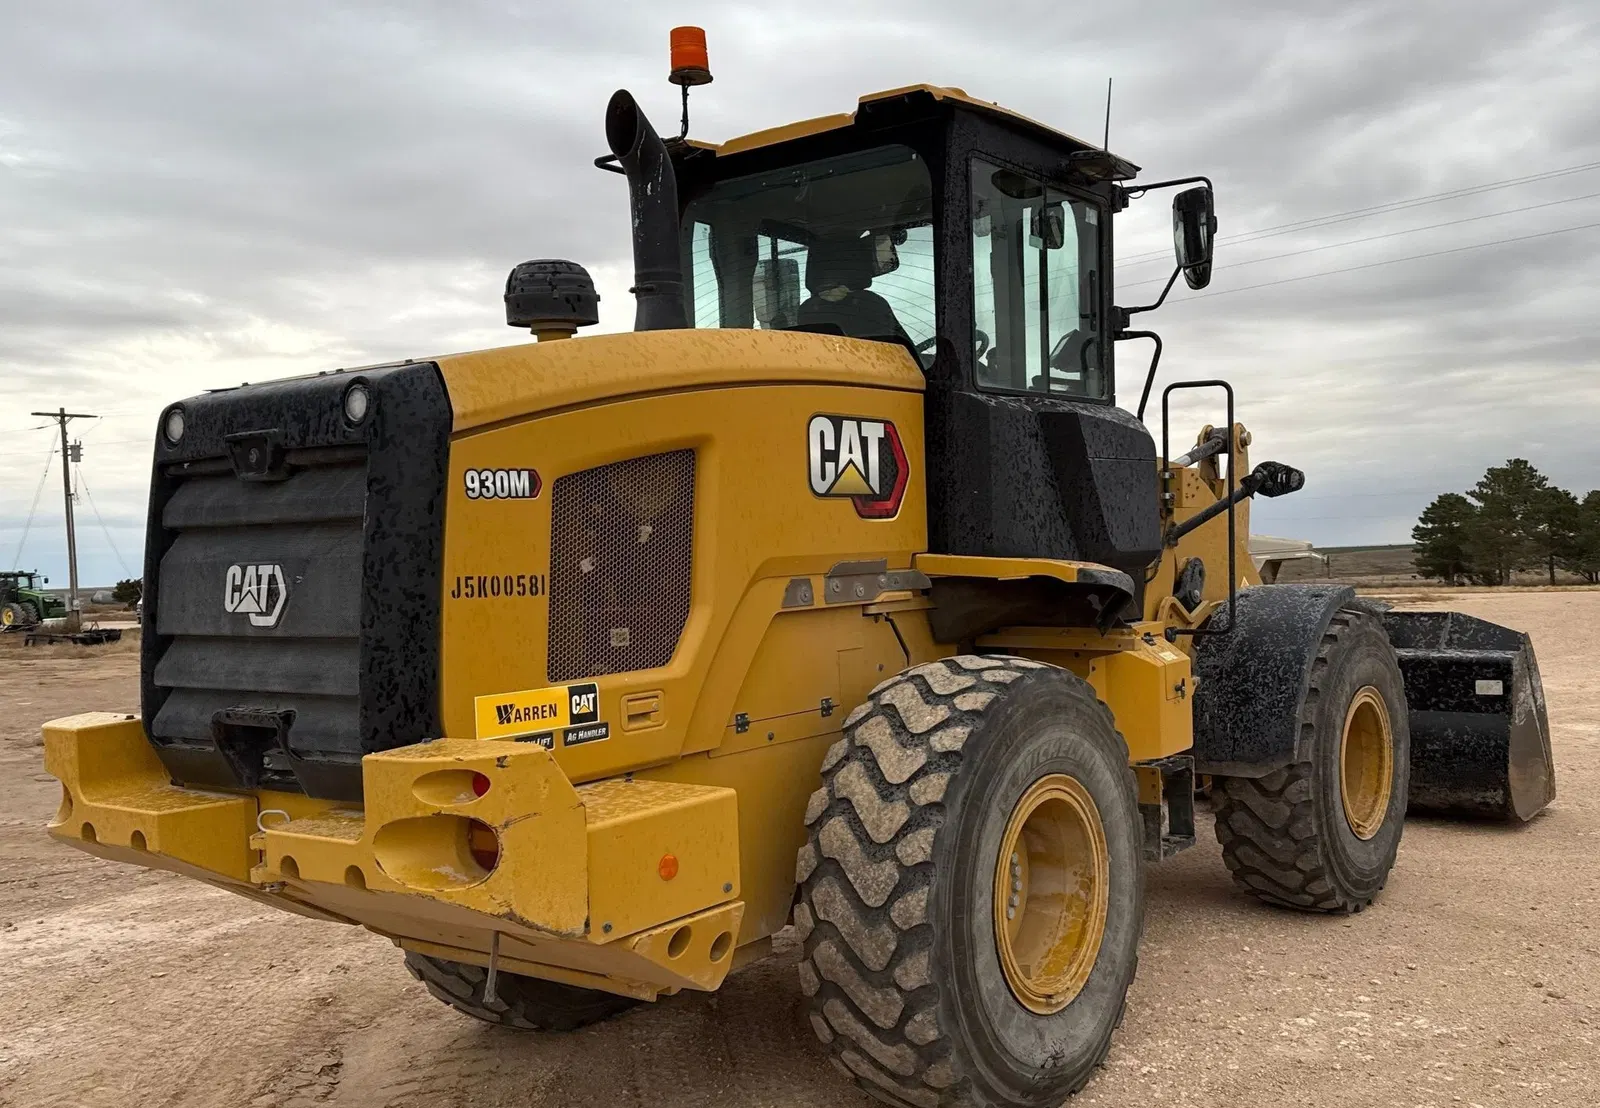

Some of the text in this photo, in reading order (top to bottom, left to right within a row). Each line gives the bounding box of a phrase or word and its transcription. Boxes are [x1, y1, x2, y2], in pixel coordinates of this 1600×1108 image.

[809, 416, 885, 495] CAT
[464, 469, 531, 498] 930M
[224, 564, 274, 613] CAT
[451, 574, 546, 599] J5K00581
[495, 703, 558, 725] WARREN
[572, 692, 596, 715] CAT
